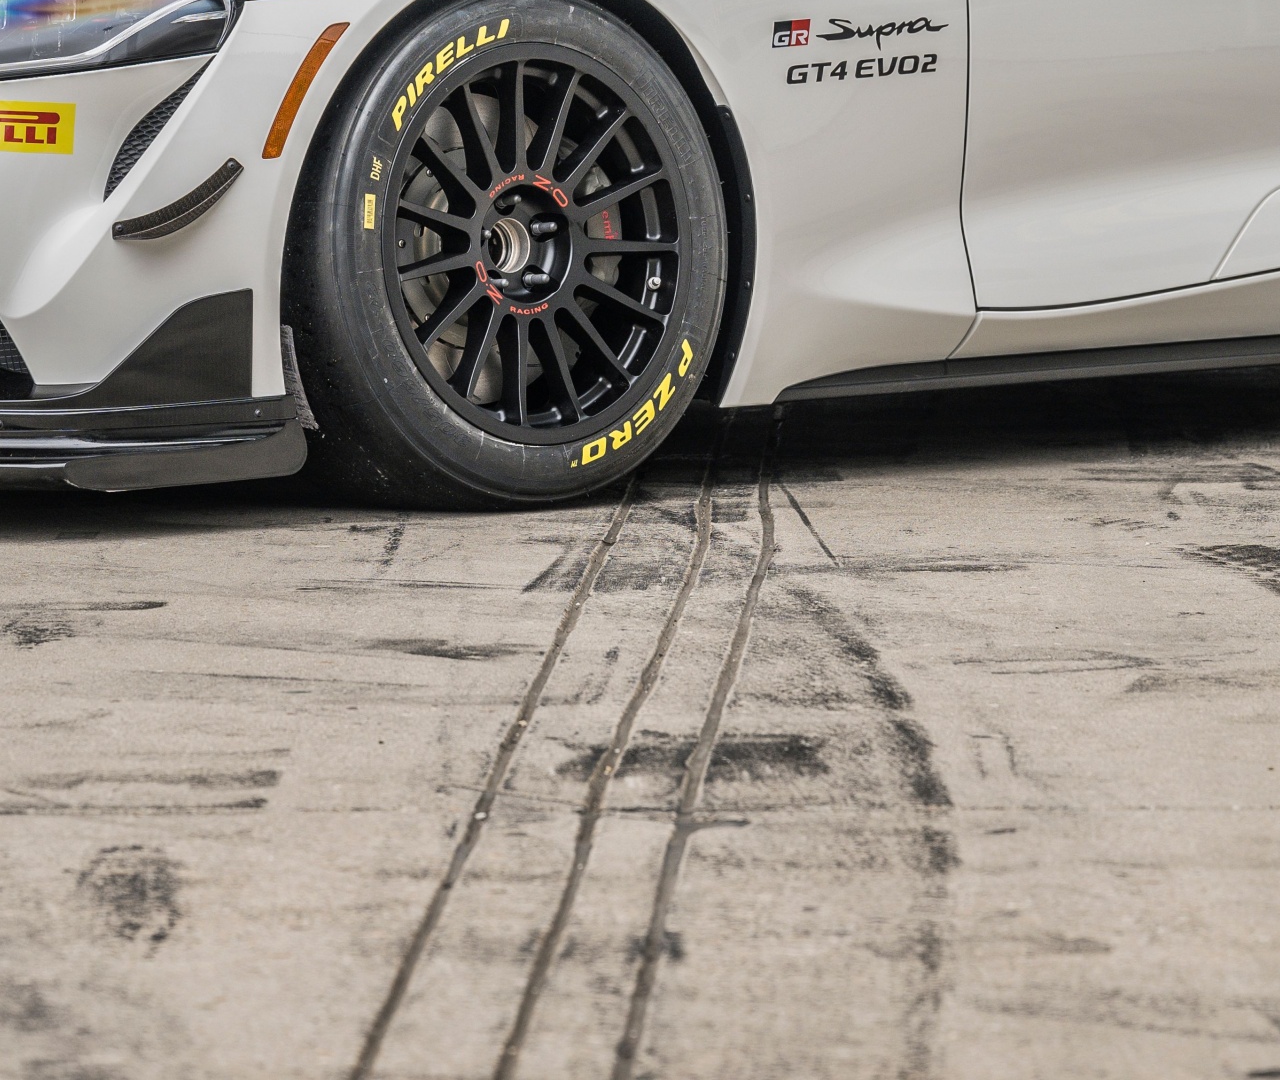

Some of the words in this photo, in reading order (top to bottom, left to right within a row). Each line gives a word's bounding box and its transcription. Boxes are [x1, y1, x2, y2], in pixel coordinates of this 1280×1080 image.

[773, 27, 809, 47] GR
[816, 17, 949, 51] Supra
[390, 18, 510, 132] PIRELLI
[786, 60, 848, 84] GT4
[854, 53, 938, 78] EVO2
[370, 155, 383, 181] DHF
[489, 174, 525, 199] RACING
[509, 302, 549, 316] RACING
